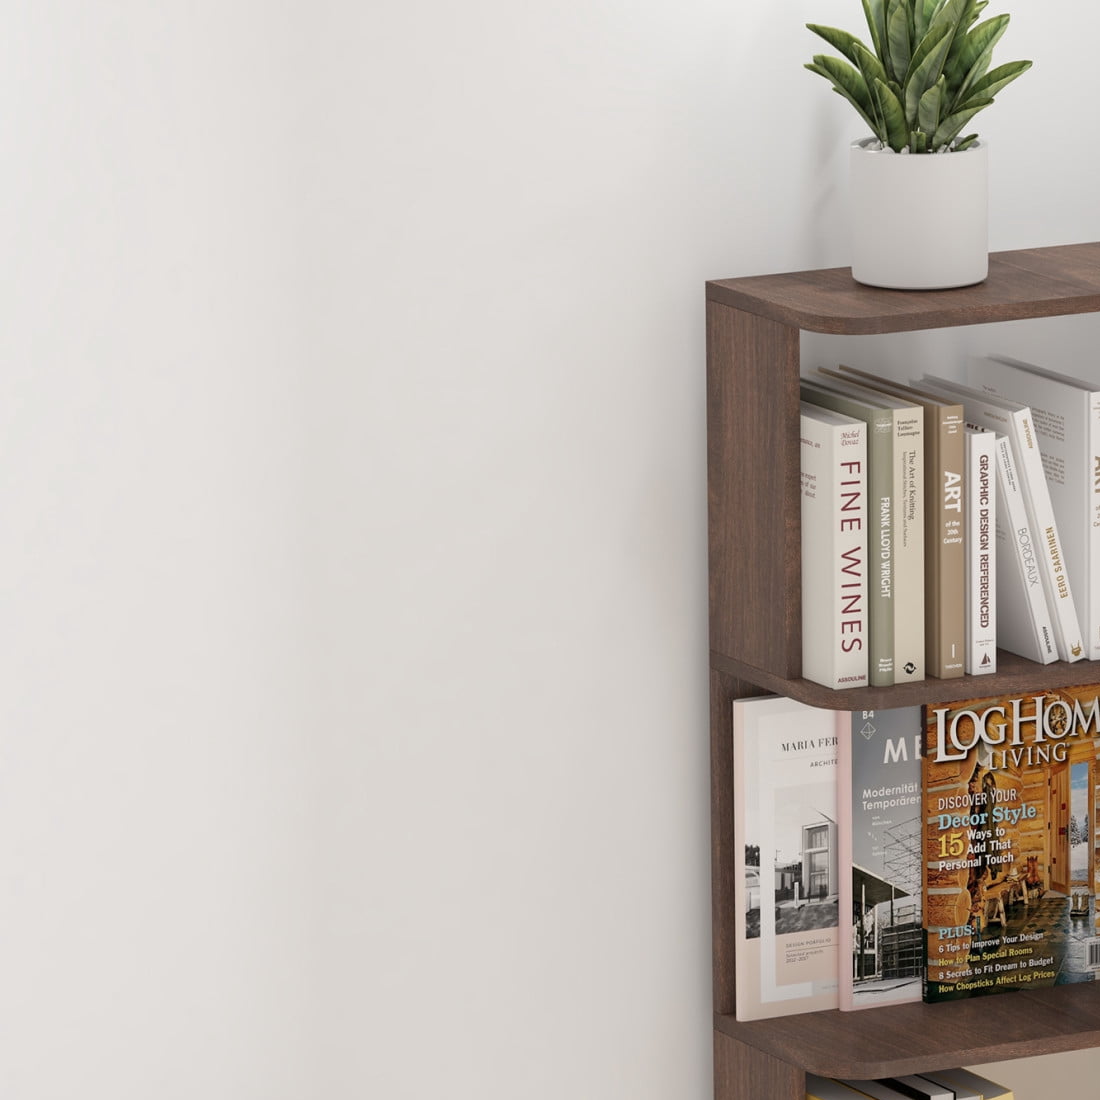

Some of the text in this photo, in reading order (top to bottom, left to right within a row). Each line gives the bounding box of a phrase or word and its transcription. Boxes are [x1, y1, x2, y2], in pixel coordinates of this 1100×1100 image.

[910, 480, 916, 489] of
[944, 471, 961, 512] ART
[907, 490, 916, 520] Knitting
[880, 497, 891, 598] FRANK LLOYD WRIGHT
[944, 536, 962, 544] Century
[980, 454, 989, 628] GRAPHIC DESIGN REFERENCED
[840, 461, 862, 653] FINE WINES
[1018, 528, 1038, 586] BORDEAUX
[1045, 526, 1068, 599] EERO SAARINEN
[1042, 626, 1052, 654] ASSOULINE
[838, 674, 866, 684] ASSOULINE
[782, 740, 815, 752] MARIA
[990, 742, 1068, 770] LIVING
[862, 782, 918, 799] Modernität
[938, 788, 1016, 810] DISCOVER YOUR
[938, 803, 1036, 830] Decor Style
[938, 827, 1006, 858] 15 Ways to
[967, 839, 1012, 854] Add That
[938, 852, 1014, 871] Personal Touch
[938, 925, 976, 940] PLUS:
[946, 944, 960, 952] Tips
[962, 942, 969, 950] to
[972, 940, 1000, 949] Improve
[1002, 936, 1018, 944] Your
[1020, 932, 1044, 942] Design
[938, 947, 1033, 967] How to Plan Special Rooms
[946, 969, 972, 979] Secrets
[975, 966, 982, 974] to
[984, 964, 993, 973] Fit
[995, 962, 1018, 972] Dream
[1020, 960, 1026, 968] to
[1029, 956, 1054, 967] Budget
[938, 970, 1055, 993] How Chopsticks Affect Log Prices
